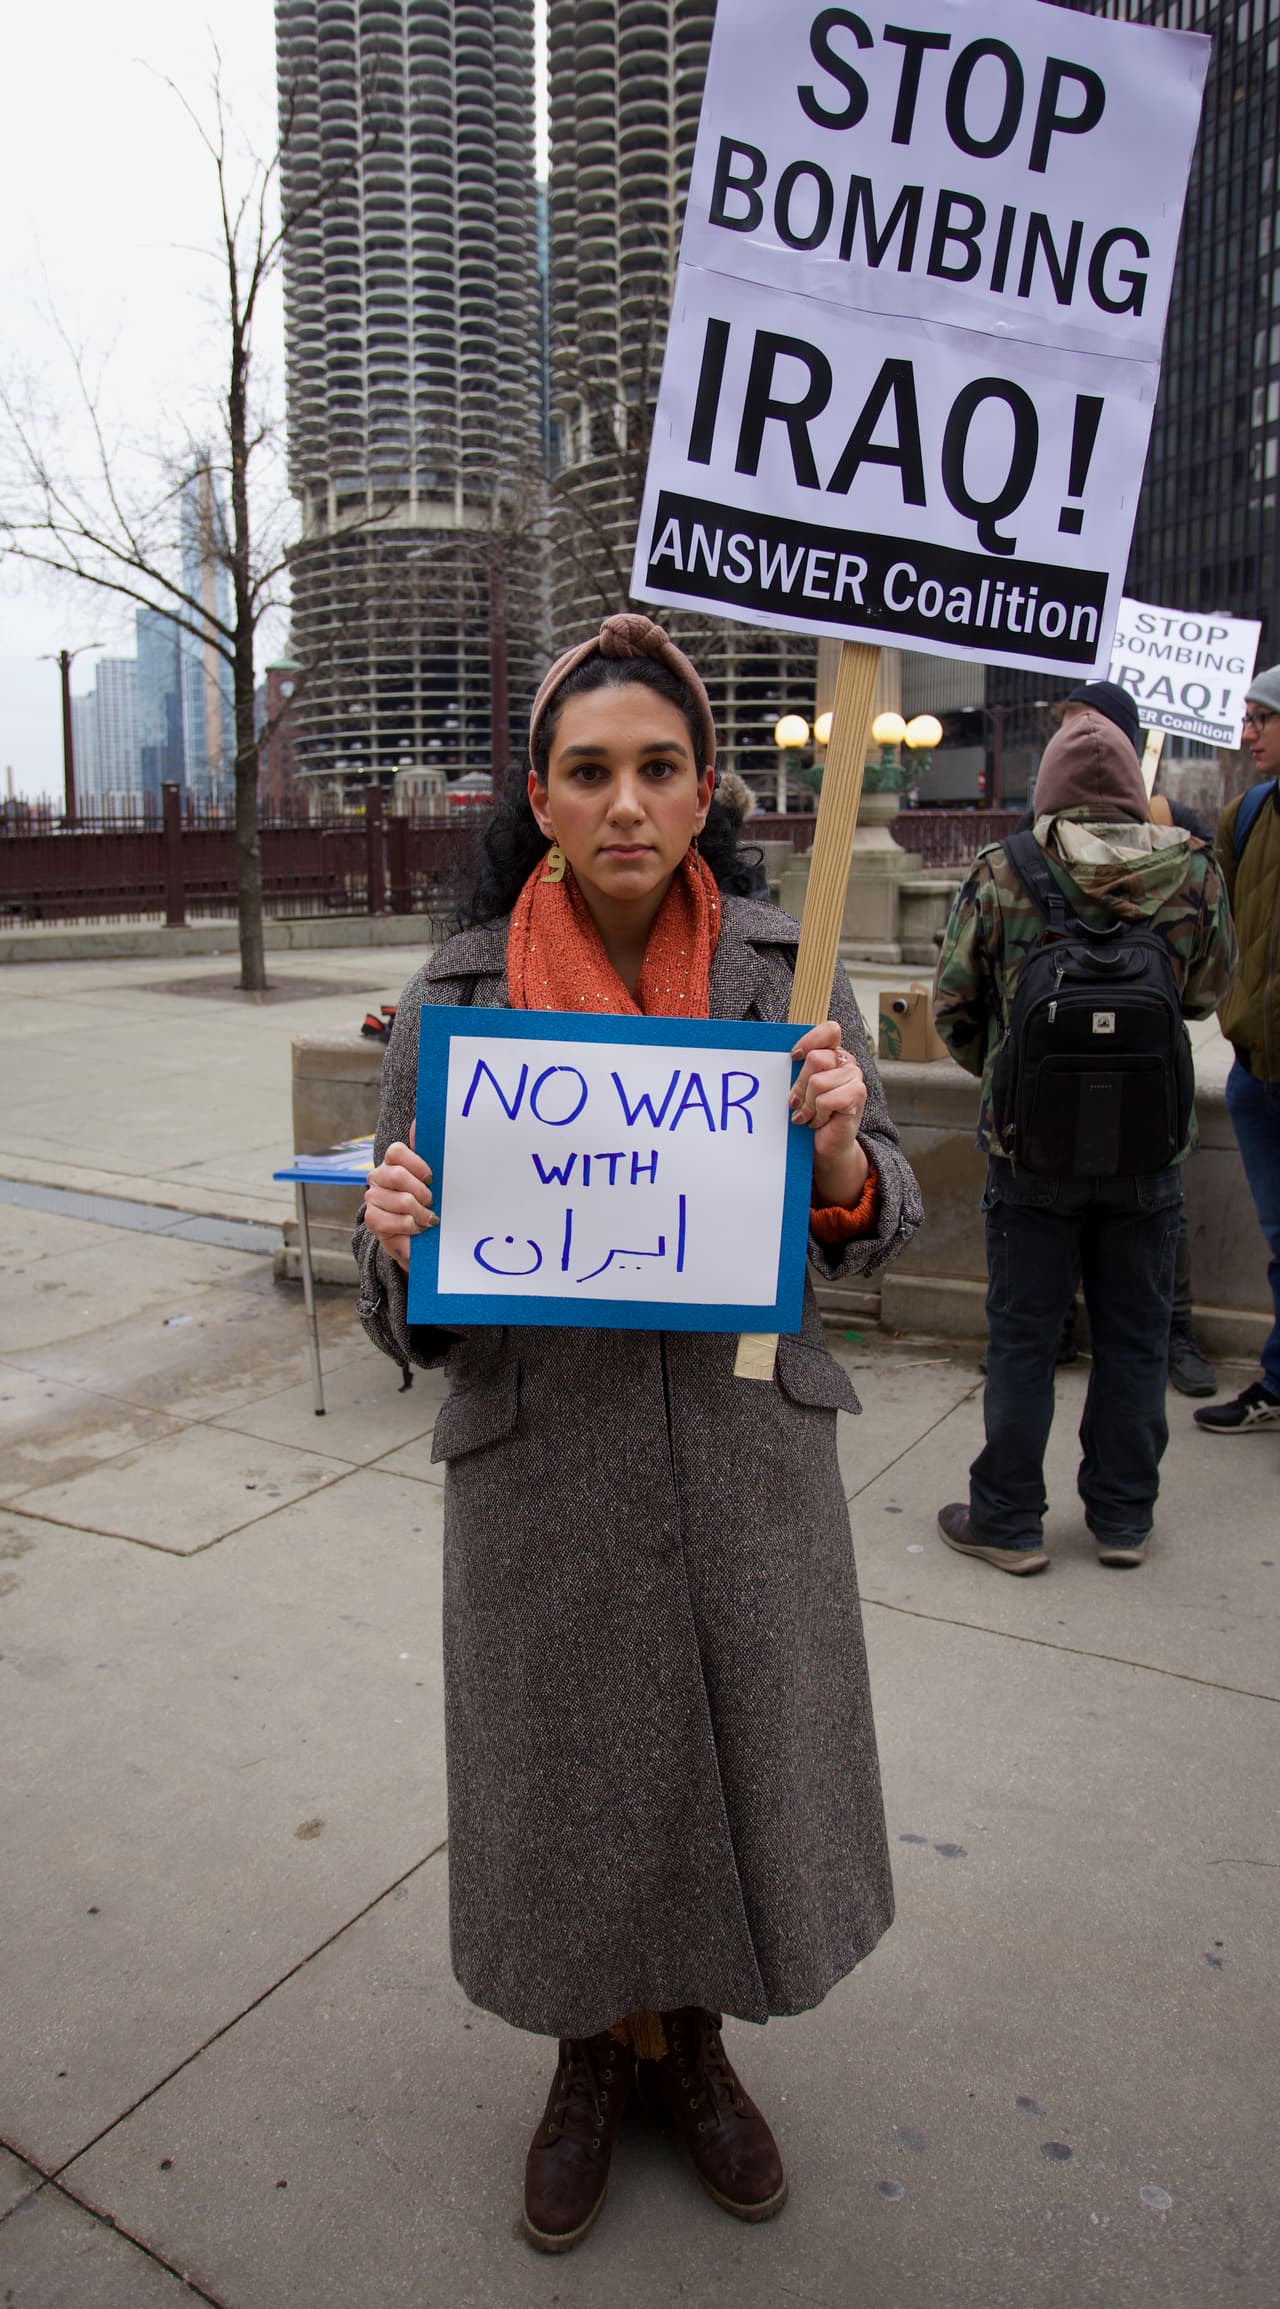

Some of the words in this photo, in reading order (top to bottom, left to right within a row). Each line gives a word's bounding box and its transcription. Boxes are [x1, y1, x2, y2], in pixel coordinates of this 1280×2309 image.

[796, 7, 1106, 174] STOP
[708, 135, 1150, 317] BOMBING
[687, 317, 1104, 555] IRAQ!
[649, 517, 867, 605] ANSWER
[882, 562, 1099, 642] Coalition
[1113, 632, 1245, 674] BOMBING
[1135, 612, 1229, 646] STOP
[1161, 714, 1233, 743] Coalition
[462, 1058, 588, 1126] NO
[610, 1069, 760, 1133] WAR
[531, 1149, 658, 1186] WITH
